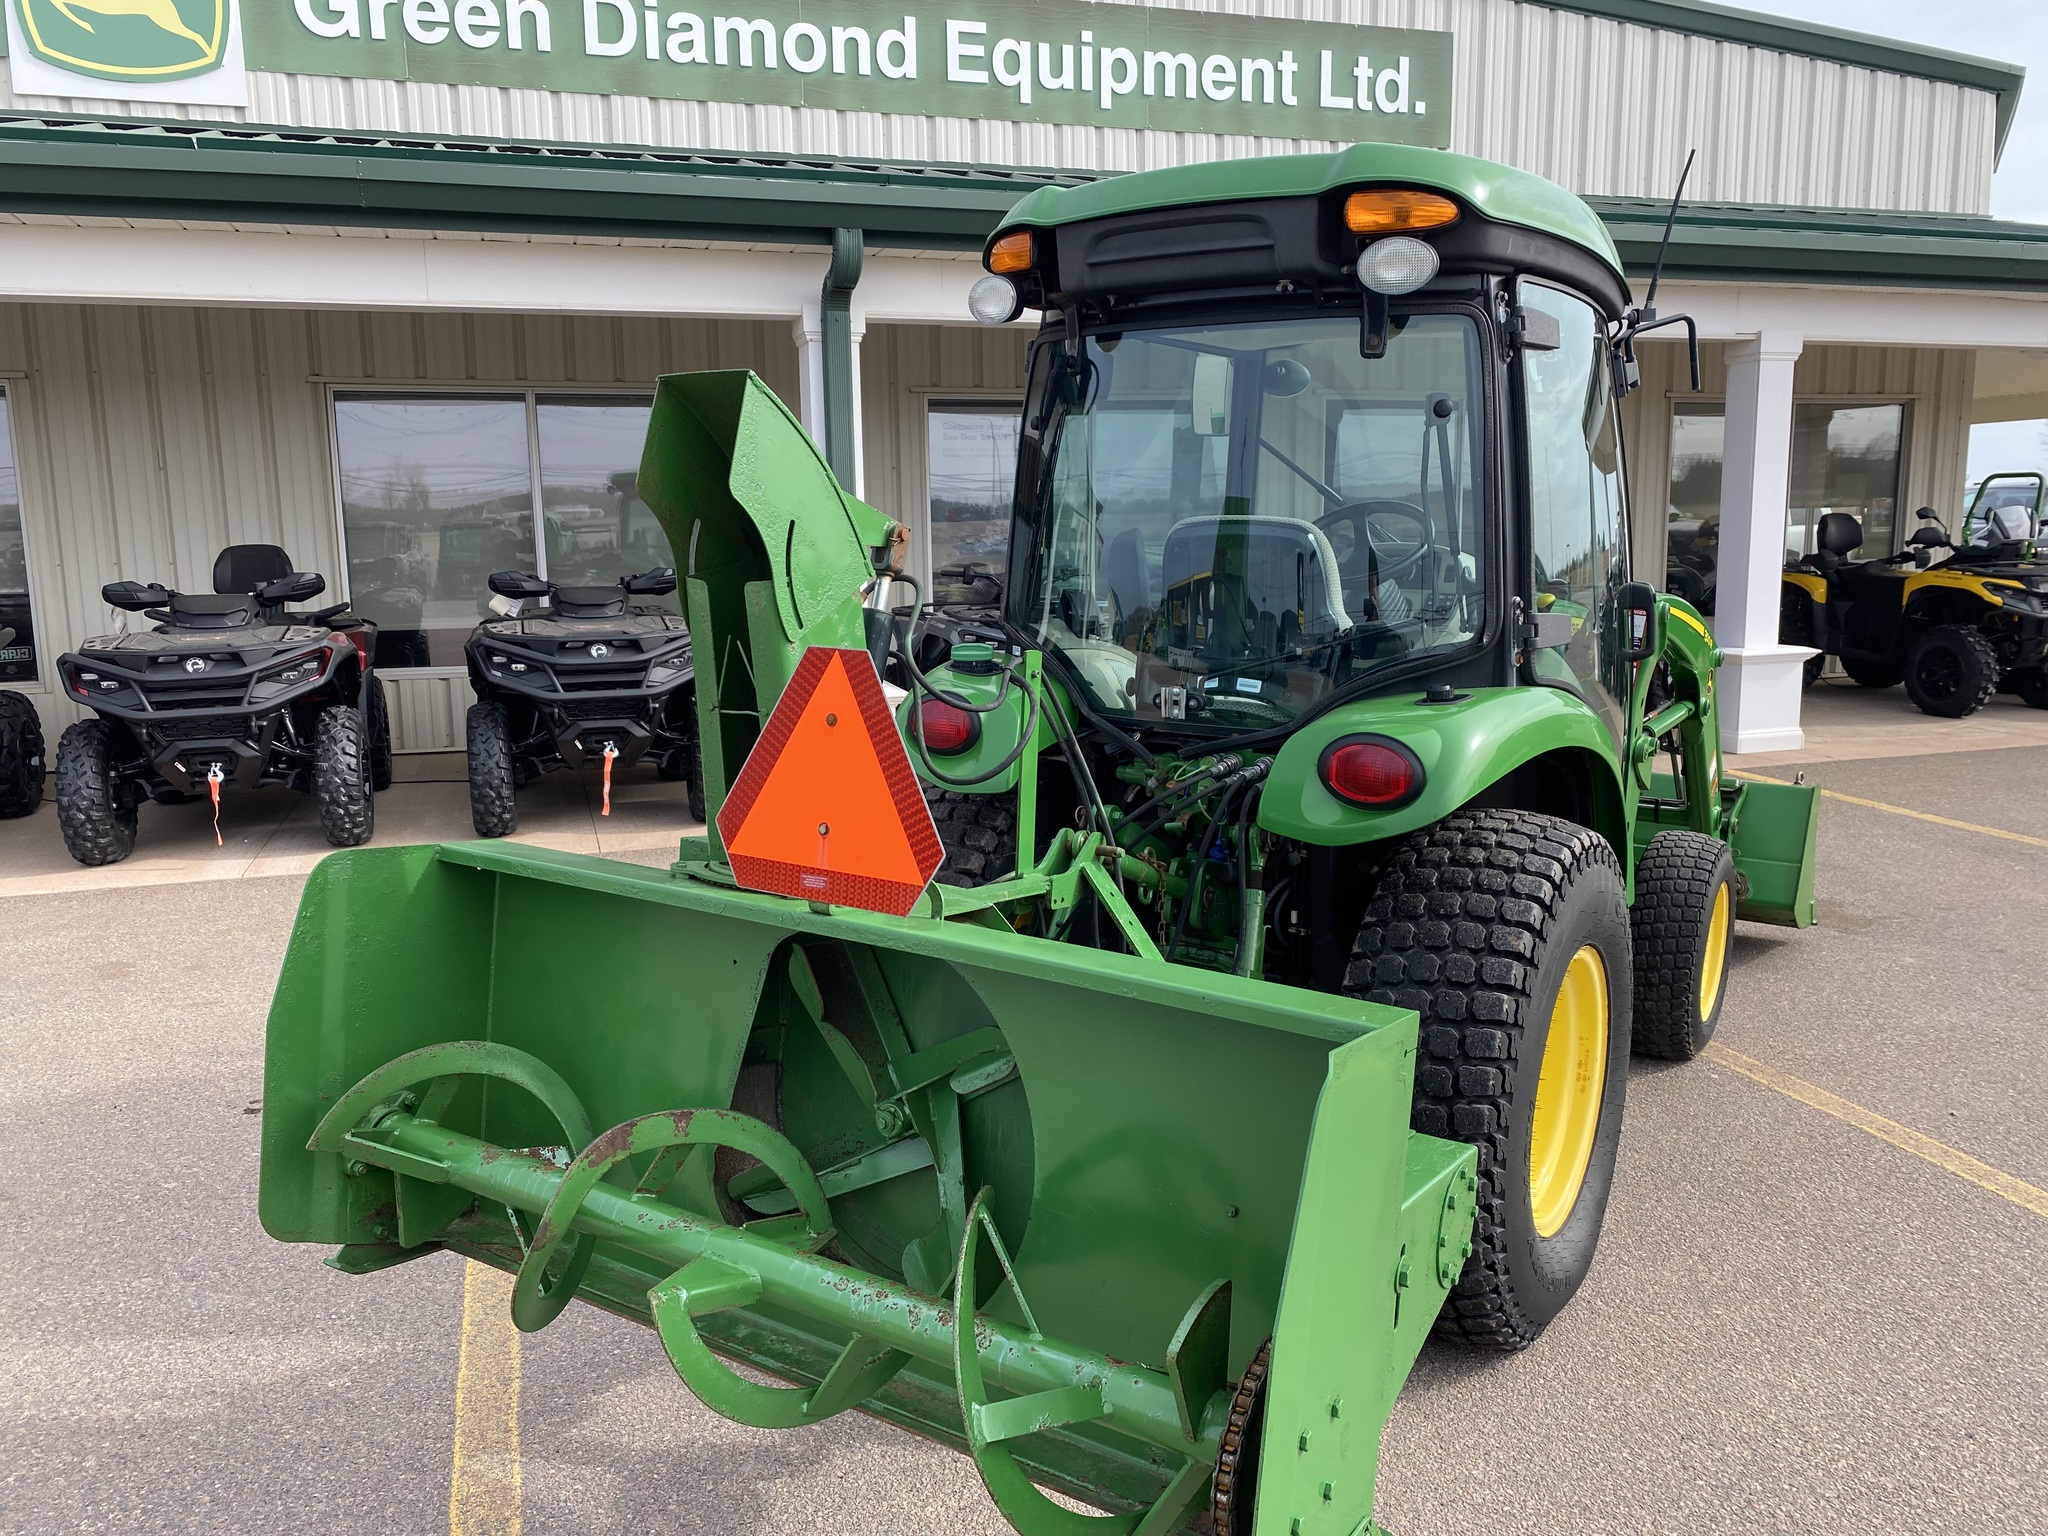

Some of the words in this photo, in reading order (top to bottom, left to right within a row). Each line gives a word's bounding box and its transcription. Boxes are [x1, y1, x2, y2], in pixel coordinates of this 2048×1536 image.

[293, 0, 552, 52] Green
[583, 0, 917, 79] Diamond
[946, 18, 1299, 110] Equipment
[1320, 49, 1427, 115] Ltd.
